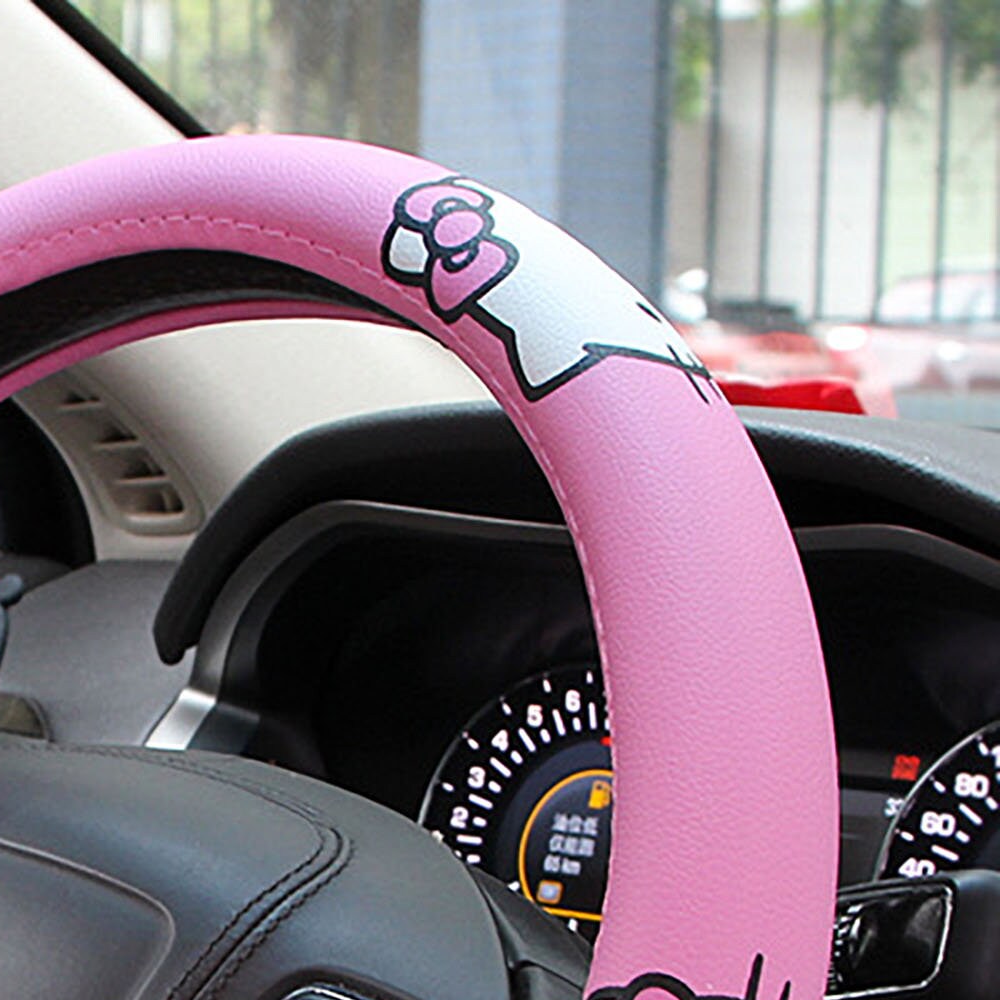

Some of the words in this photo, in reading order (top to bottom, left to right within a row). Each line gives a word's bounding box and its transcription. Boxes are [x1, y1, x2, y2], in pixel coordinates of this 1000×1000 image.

[565, 690, 581, 712] 6
[527, 705, 543, 727] 5
[491, 730, 508, 751] 4
[468, 767, 485, 788] 3
[954, 773, 989, 798] 80
[450, 807, 469, 828] 2
[920, 811, 955, 836] 60
[899, 858, 935, 878] 40
